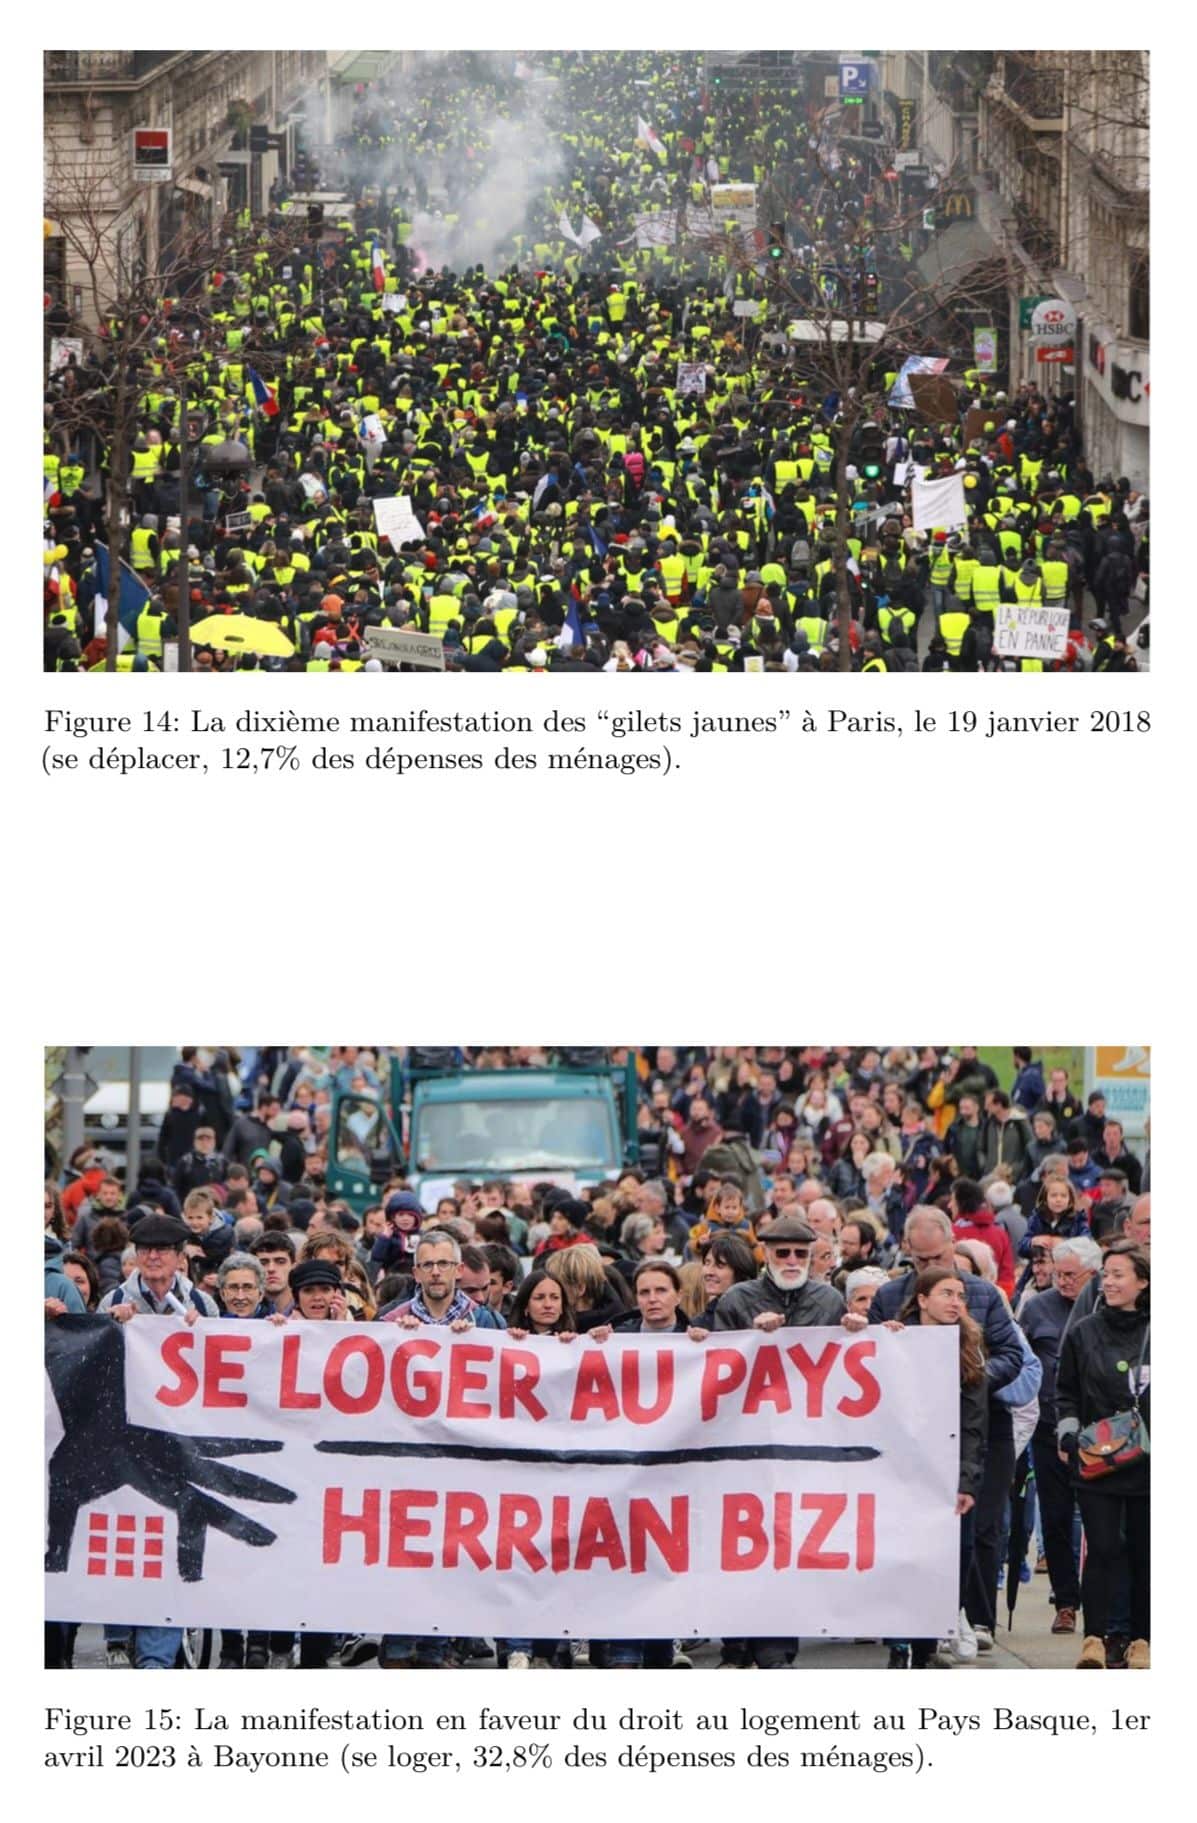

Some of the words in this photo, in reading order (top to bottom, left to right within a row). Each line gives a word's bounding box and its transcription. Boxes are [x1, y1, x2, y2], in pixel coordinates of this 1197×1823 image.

[842, 66, 859, 87] P
[1036, 323, 1074, 335] HSBC
[998, 630, 1018, 649] EN
[1024, 632, 1065, 653] PANNE
[156, 1332, 252, 1408] SE
[280, 1334, 548, 1422] LOGER
[570, 1350, 674, 1424] AU
[701, 1341, 881, 1422] PAYS
[322, 1487, 690, 1575] HERRIAN
[720, 1492, 876, 1573] BIZI
